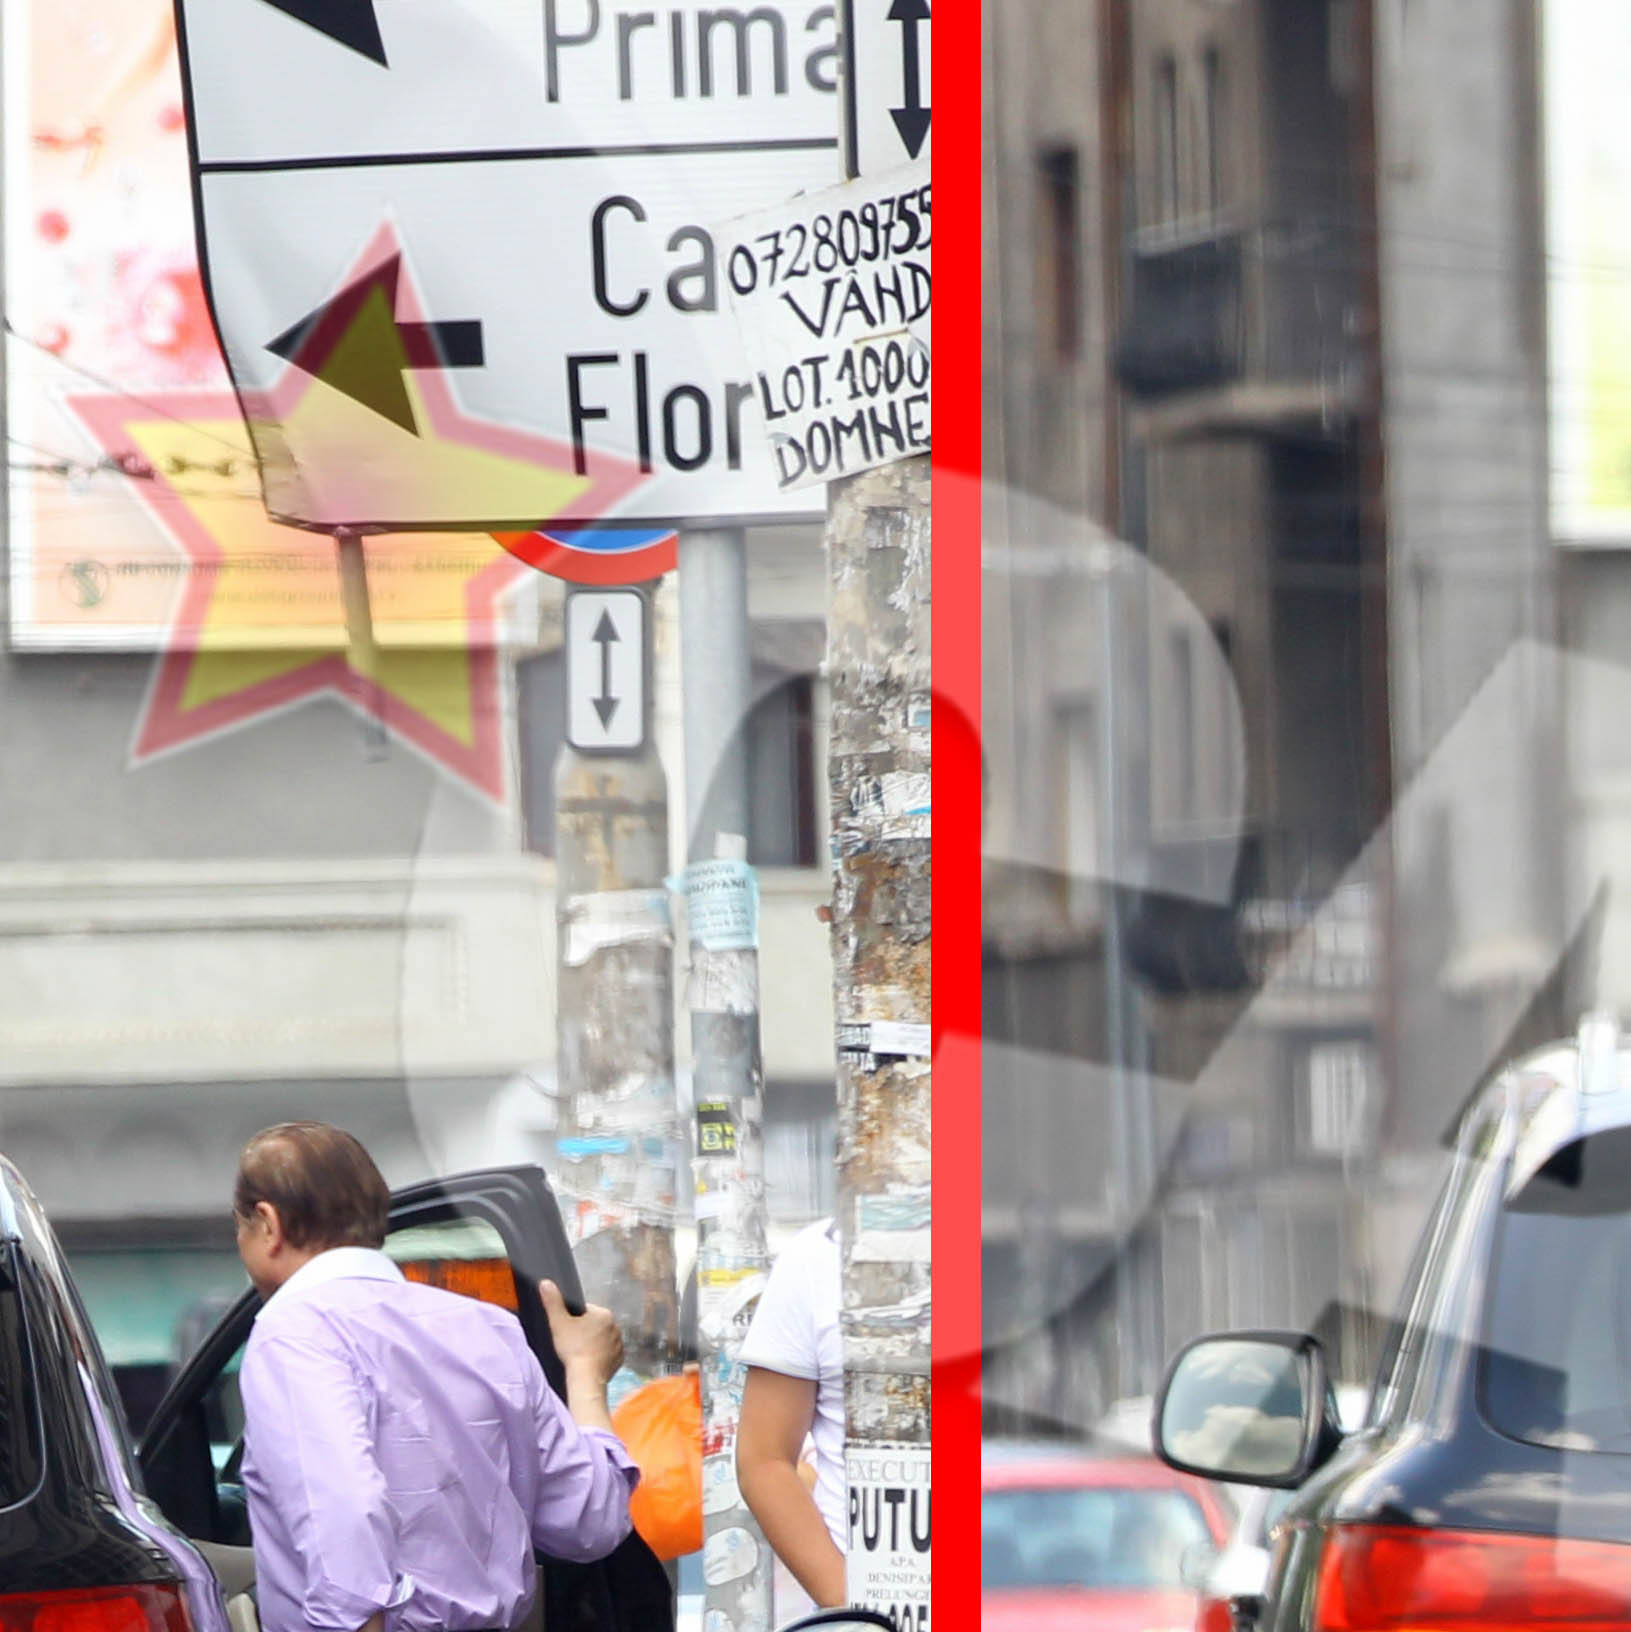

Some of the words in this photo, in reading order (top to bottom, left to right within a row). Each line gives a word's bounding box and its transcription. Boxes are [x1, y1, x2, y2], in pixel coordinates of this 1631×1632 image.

[544, 0, 838, 103] Prima
[591, 194, 718, 317] Ca
[728, 184, 930, 295] 072809755
[566, 352, 754, 475] Flor
[776, 393, 930, 488] DOMNE
[849, 1486, 930, 1553] PUTU
